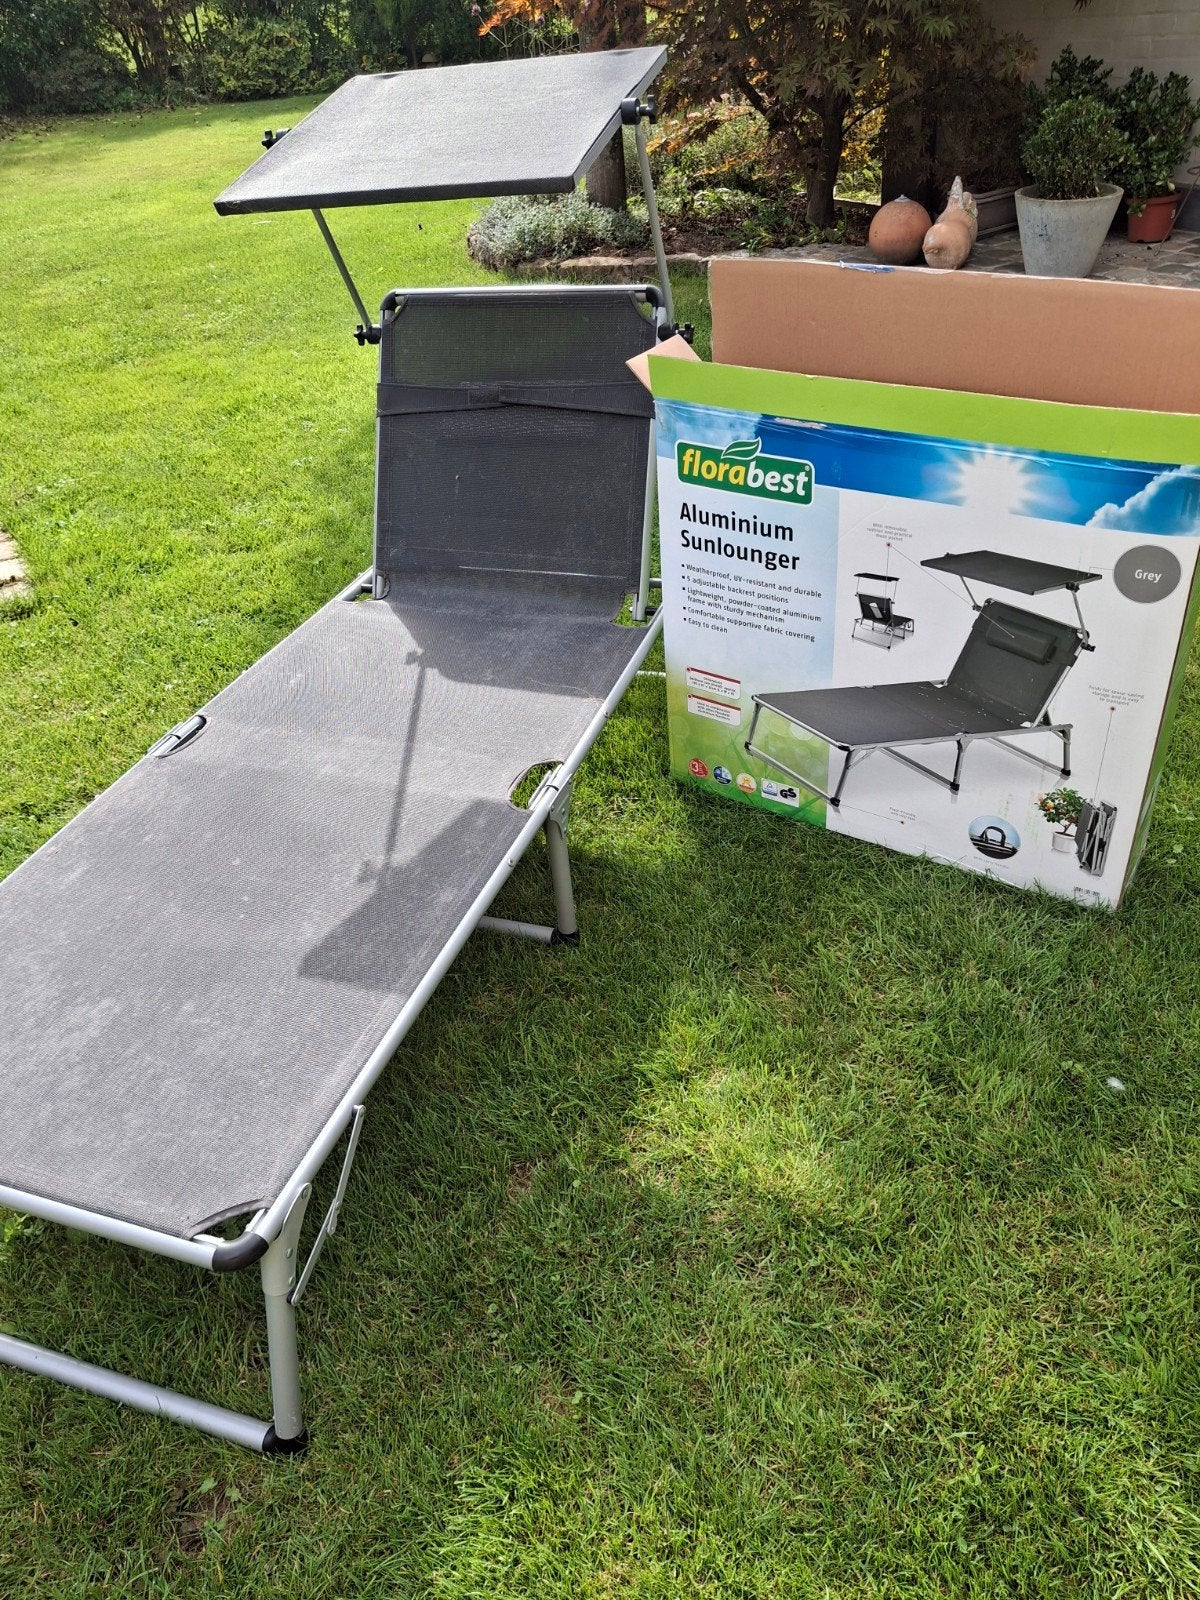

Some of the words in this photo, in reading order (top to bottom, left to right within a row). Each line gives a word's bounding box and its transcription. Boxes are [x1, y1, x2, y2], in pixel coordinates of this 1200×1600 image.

[683, 449, 808, 496] florabest
[680, 502, 794, 541] Aluminium
[681, 530, 800, 571] Sunlounger
[686, 564, 732, 581] Weatherproof,
[734, 575, 776, 590] UV-resistant
[794, 587, 822, 598] durable
[692, 577, 726, 590] adjustable
[728, 585, 755, 597] backrest
[757, 592, 789, 603] positions
[1134, 569, 1162, 583] Grey
[687, 587, 726, 603] Lightweight,
[729, 598, 780, 613] powder-coated
[783, 609, 821, 622] aluminium
[687, 595, 706, 605] frame
[707, 600, 721, 609] with
[724, 605, 744, 616] sturdy
[746, 610, 785, 623] mechanism
[688, 606, 725, 622] Comfortable
[727, 617, 762, 630] supportive
[763, 624, 783, 634] fabric
[785, 630, 815, 643] covering
[688, 617, 702, 627] Easy
[711, 624, 728, 633] clean
[780, 788, 797, 799] GS
